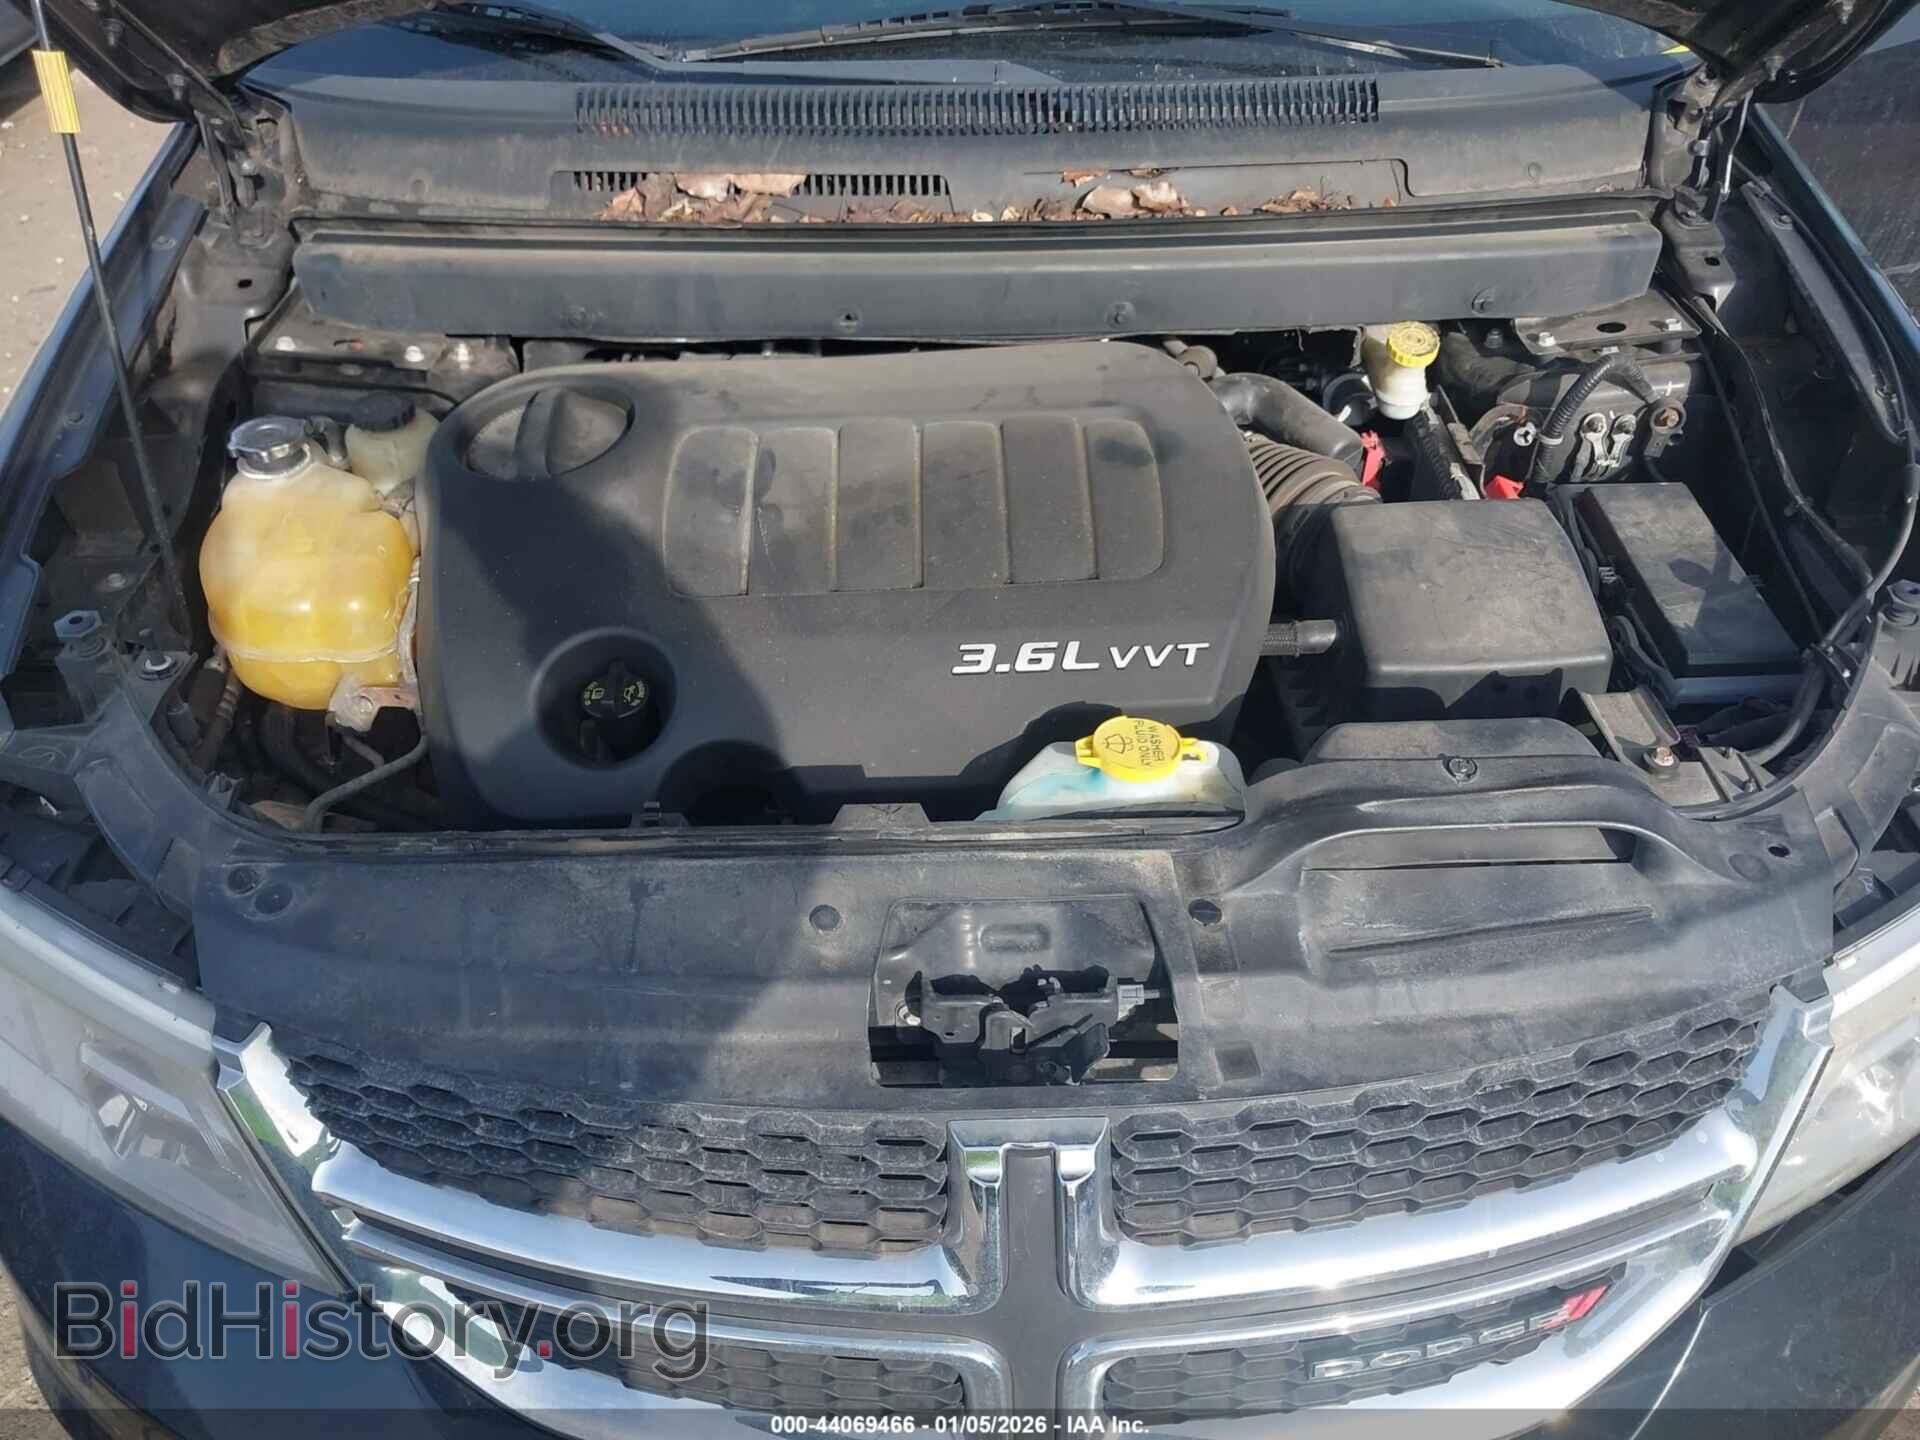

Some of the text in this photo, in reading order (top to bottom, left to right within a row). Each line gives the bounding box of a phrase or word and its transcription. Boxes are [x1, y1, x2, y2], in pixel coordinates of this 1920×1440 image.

[951, 640, 1210, 674] 3.6L VVT
[1134, 720, 1153, 767] FLUID ONLY
[1147, 725, 1165, 761] WASHER
